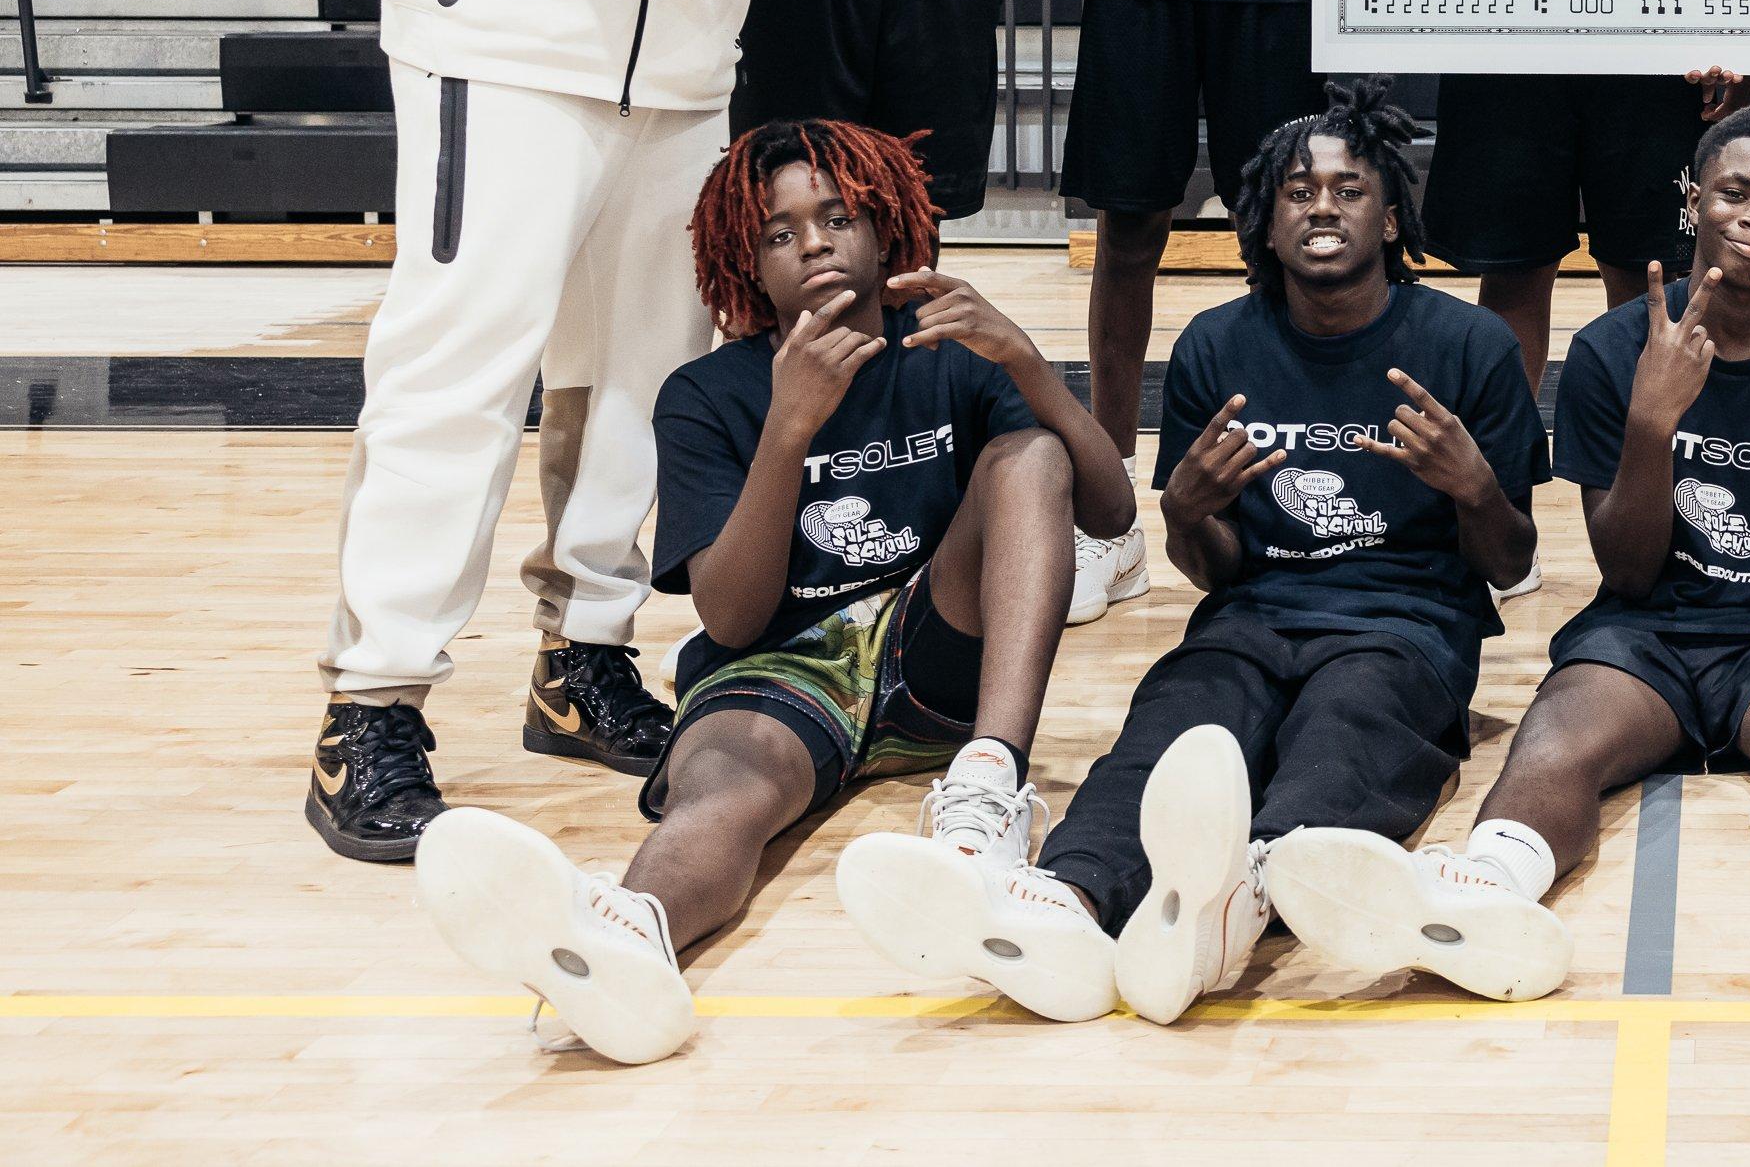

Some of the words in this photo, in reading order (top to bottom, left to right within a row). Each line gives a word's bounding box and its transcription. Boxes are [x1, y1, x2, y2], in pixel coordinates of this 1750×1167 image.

[1302, 476, 1335, 484] HIBBETT
[1302, 484, 1318, 492] CITY
[1318, 484, 1335, 492] GEAR
[1701, 490, 1726, 499] HIBBETT
[842, 510, 861, 519] GEAR
[1304, 497, 1356, 516] SOLE
[1312, 512, 1387, 537] SCHOOL
[1702, 511, 1746, 532] SOLE
[832, 519, 886, 548] SOLE
[844, 527, 920, 566] SCHOOL
[1266, 536, 1386, 560] #SOLEDOUT24
